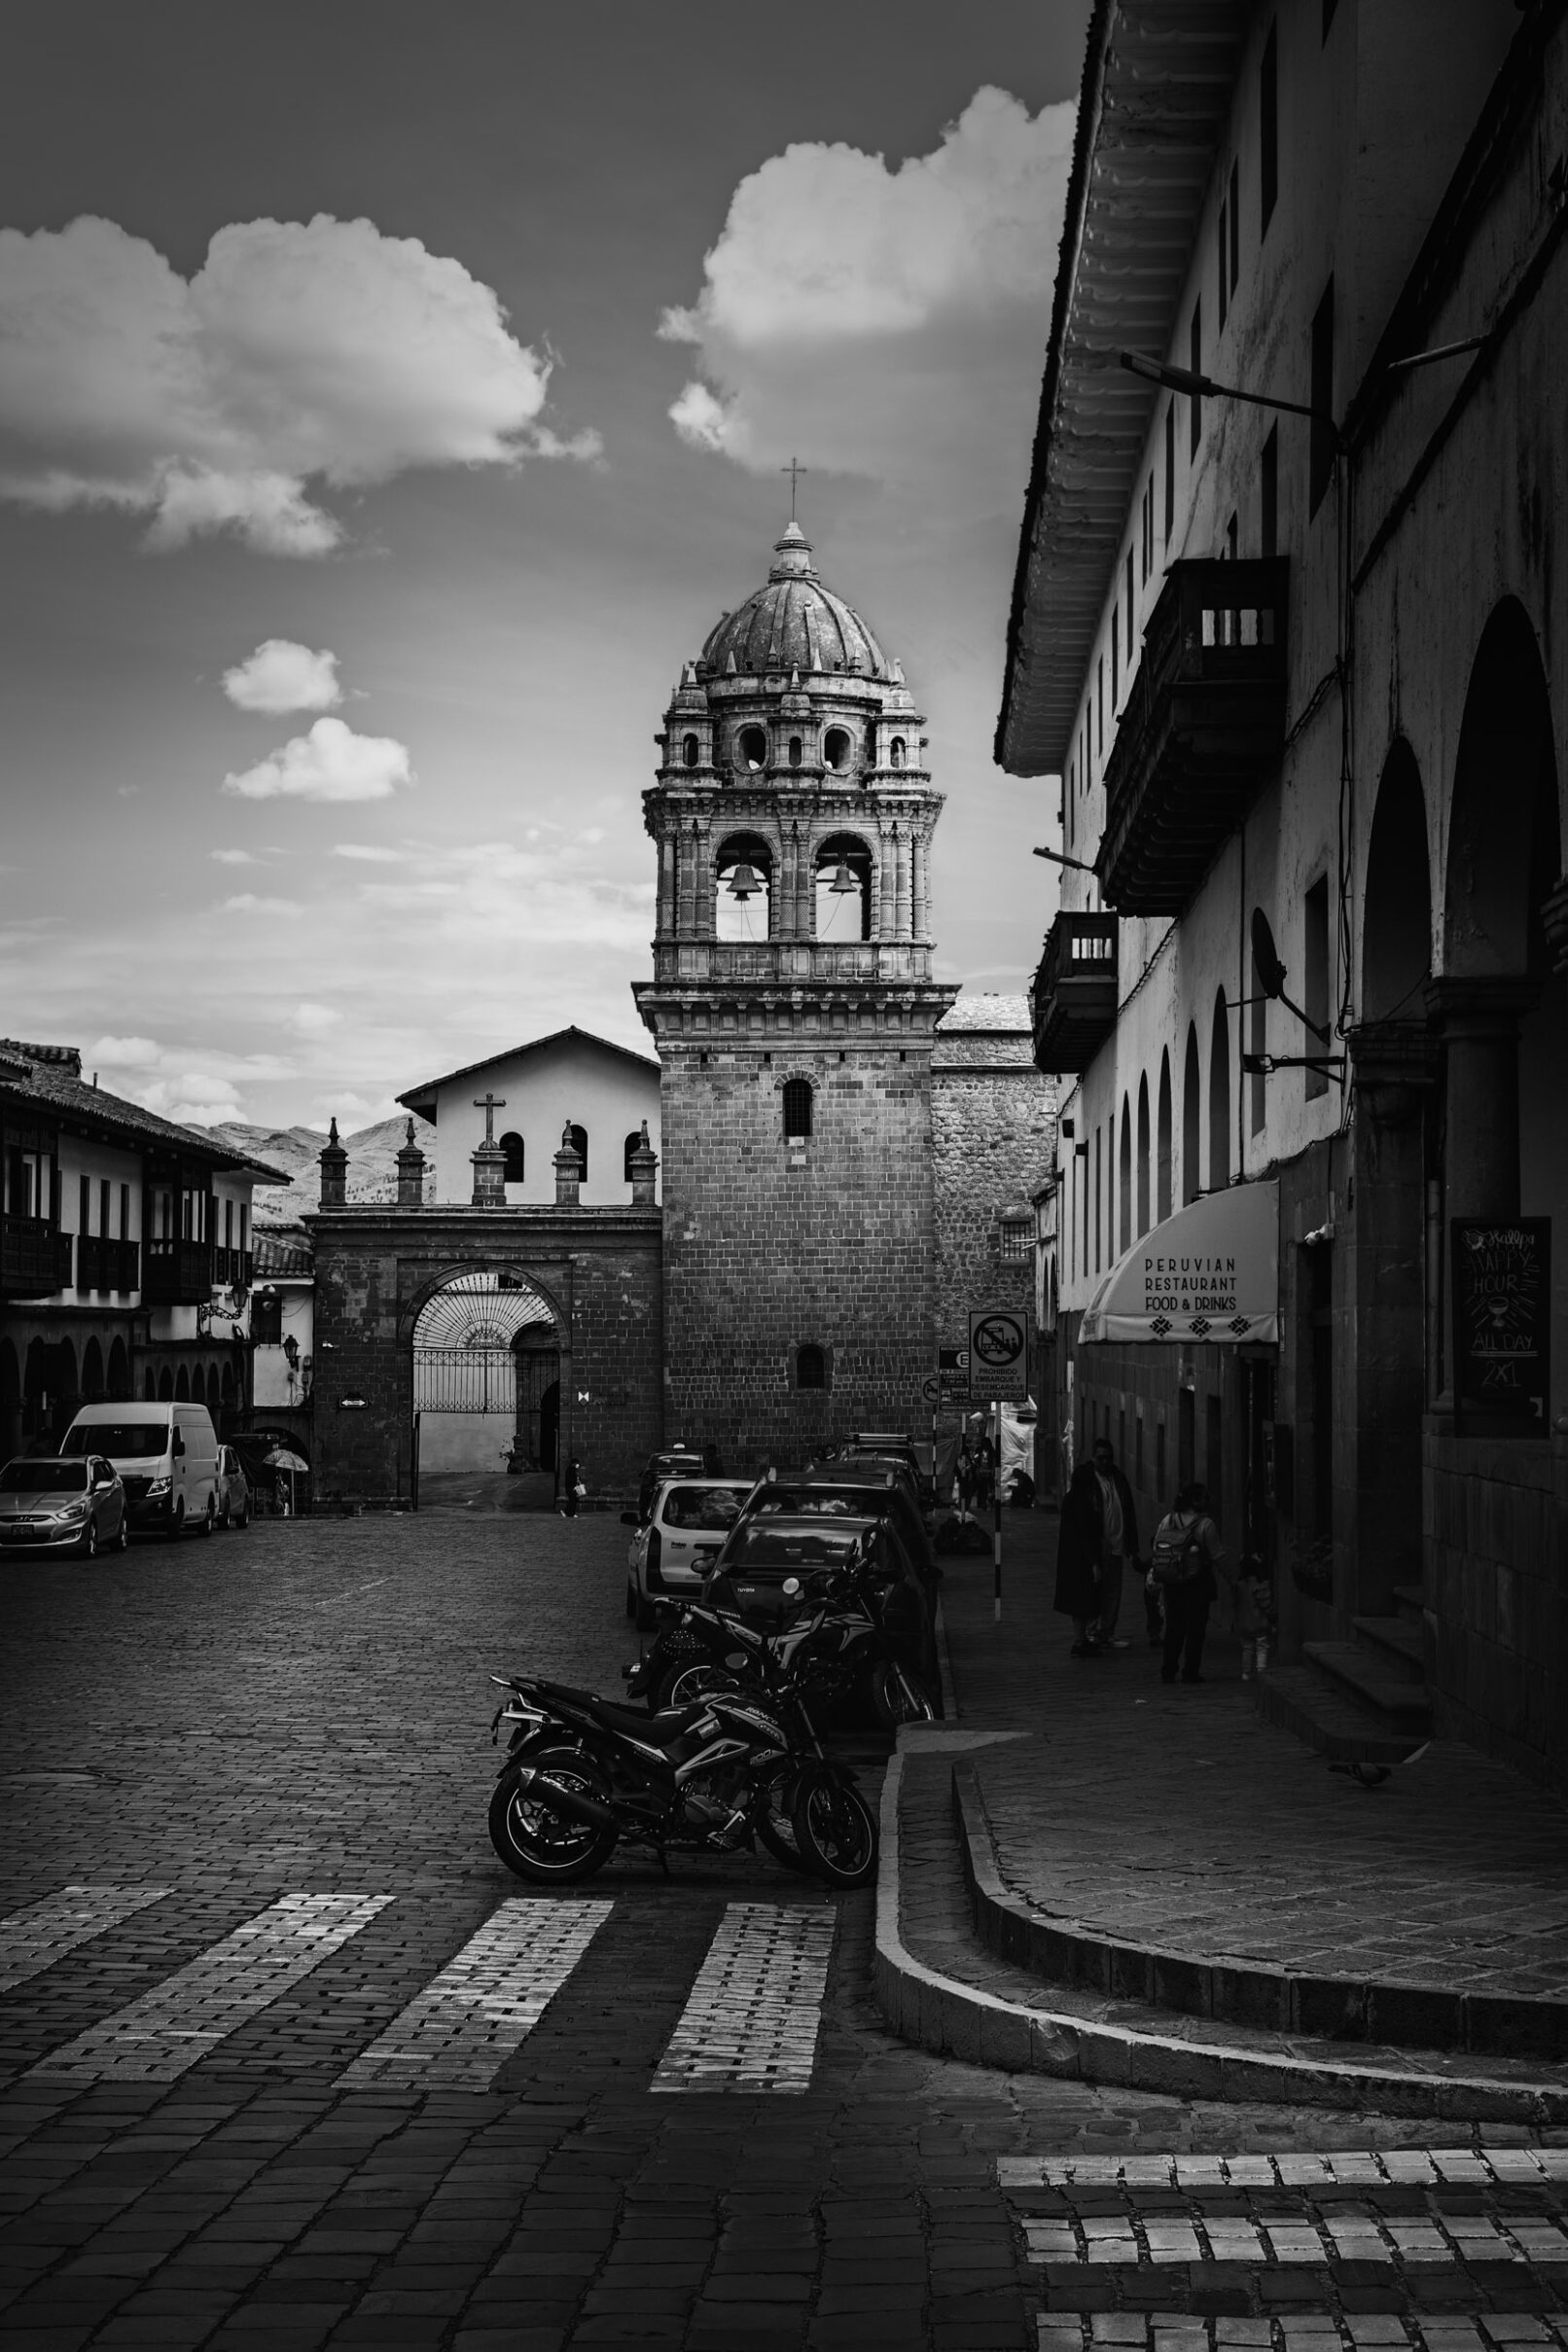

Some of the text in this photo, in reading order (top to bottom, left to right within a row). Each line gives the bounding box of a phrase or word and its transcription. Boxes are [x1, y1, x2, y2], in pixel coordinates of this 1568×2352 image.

[1145, 1258, 1236, 1272] PERUVIAN
[1470, 1249, 1532, 1274] HAPPY
[1145, 1276, 1237, 1292] RESTAURANT
[1473, 1274, 1519, 1294] HOUR
[1145, 1296, 1237, 1311] FOOD & DRINKS
[1472, 1332, 1534, 1351] ALL DAY
